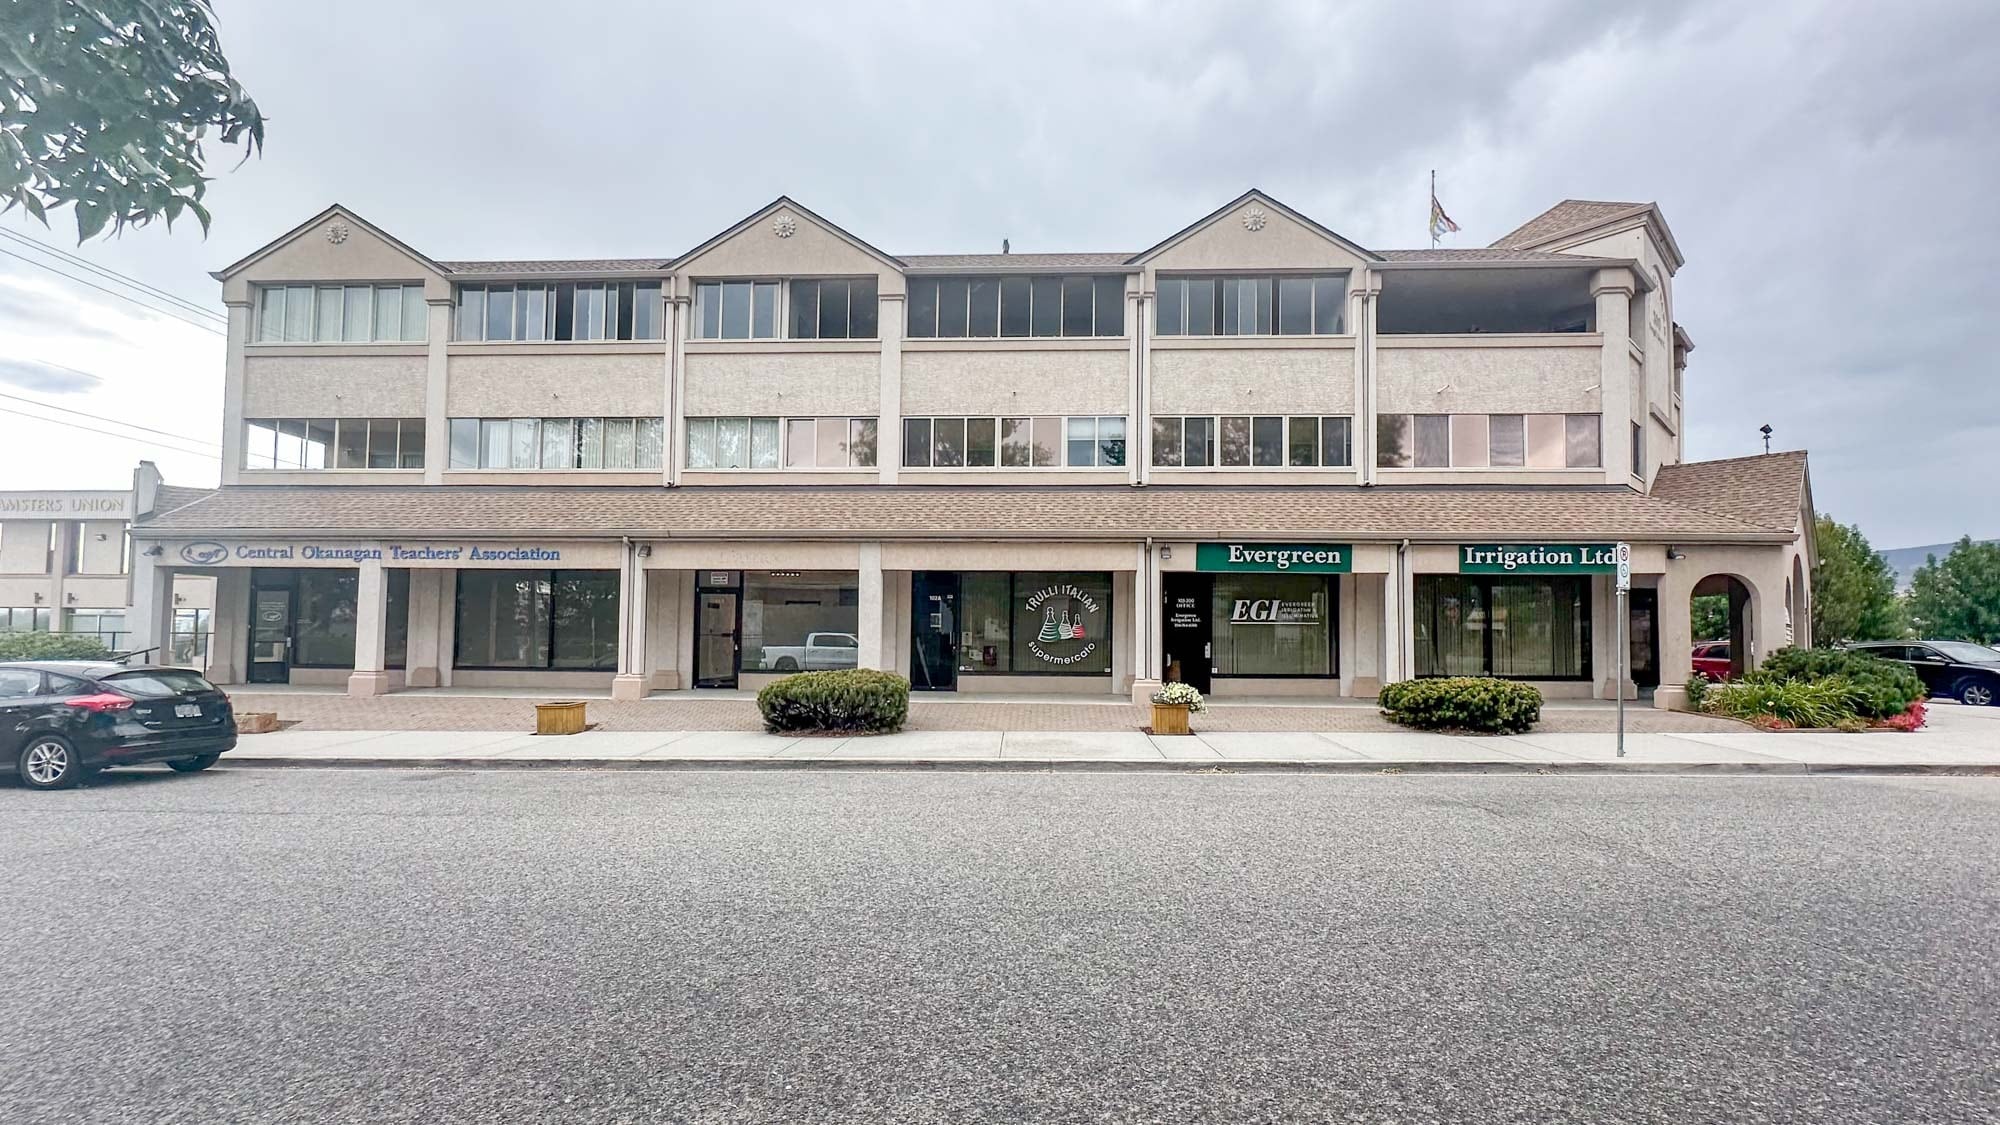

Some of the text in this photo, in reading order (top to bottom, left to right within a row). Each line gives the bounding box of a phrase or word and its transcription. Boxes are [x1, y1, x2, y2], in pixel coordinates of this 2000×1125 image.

[72, 498, 124, 512] UNION
[236, 545, 294, 560] Central
[301, 545, 381, 562] Okanagan
[389, 545, 463, 560] Teachers'
[469, 545, 561, 561] Association
[1228, 545, 1341, 569] Evergreen
[1464, 547, 1574, 570] Irrigation
[1025, 584, 1100, 613] TRULLI ITALIAN
[1230, 599, 1282, 621] EGI
[1028, 641, 1096, 664] supermercato
